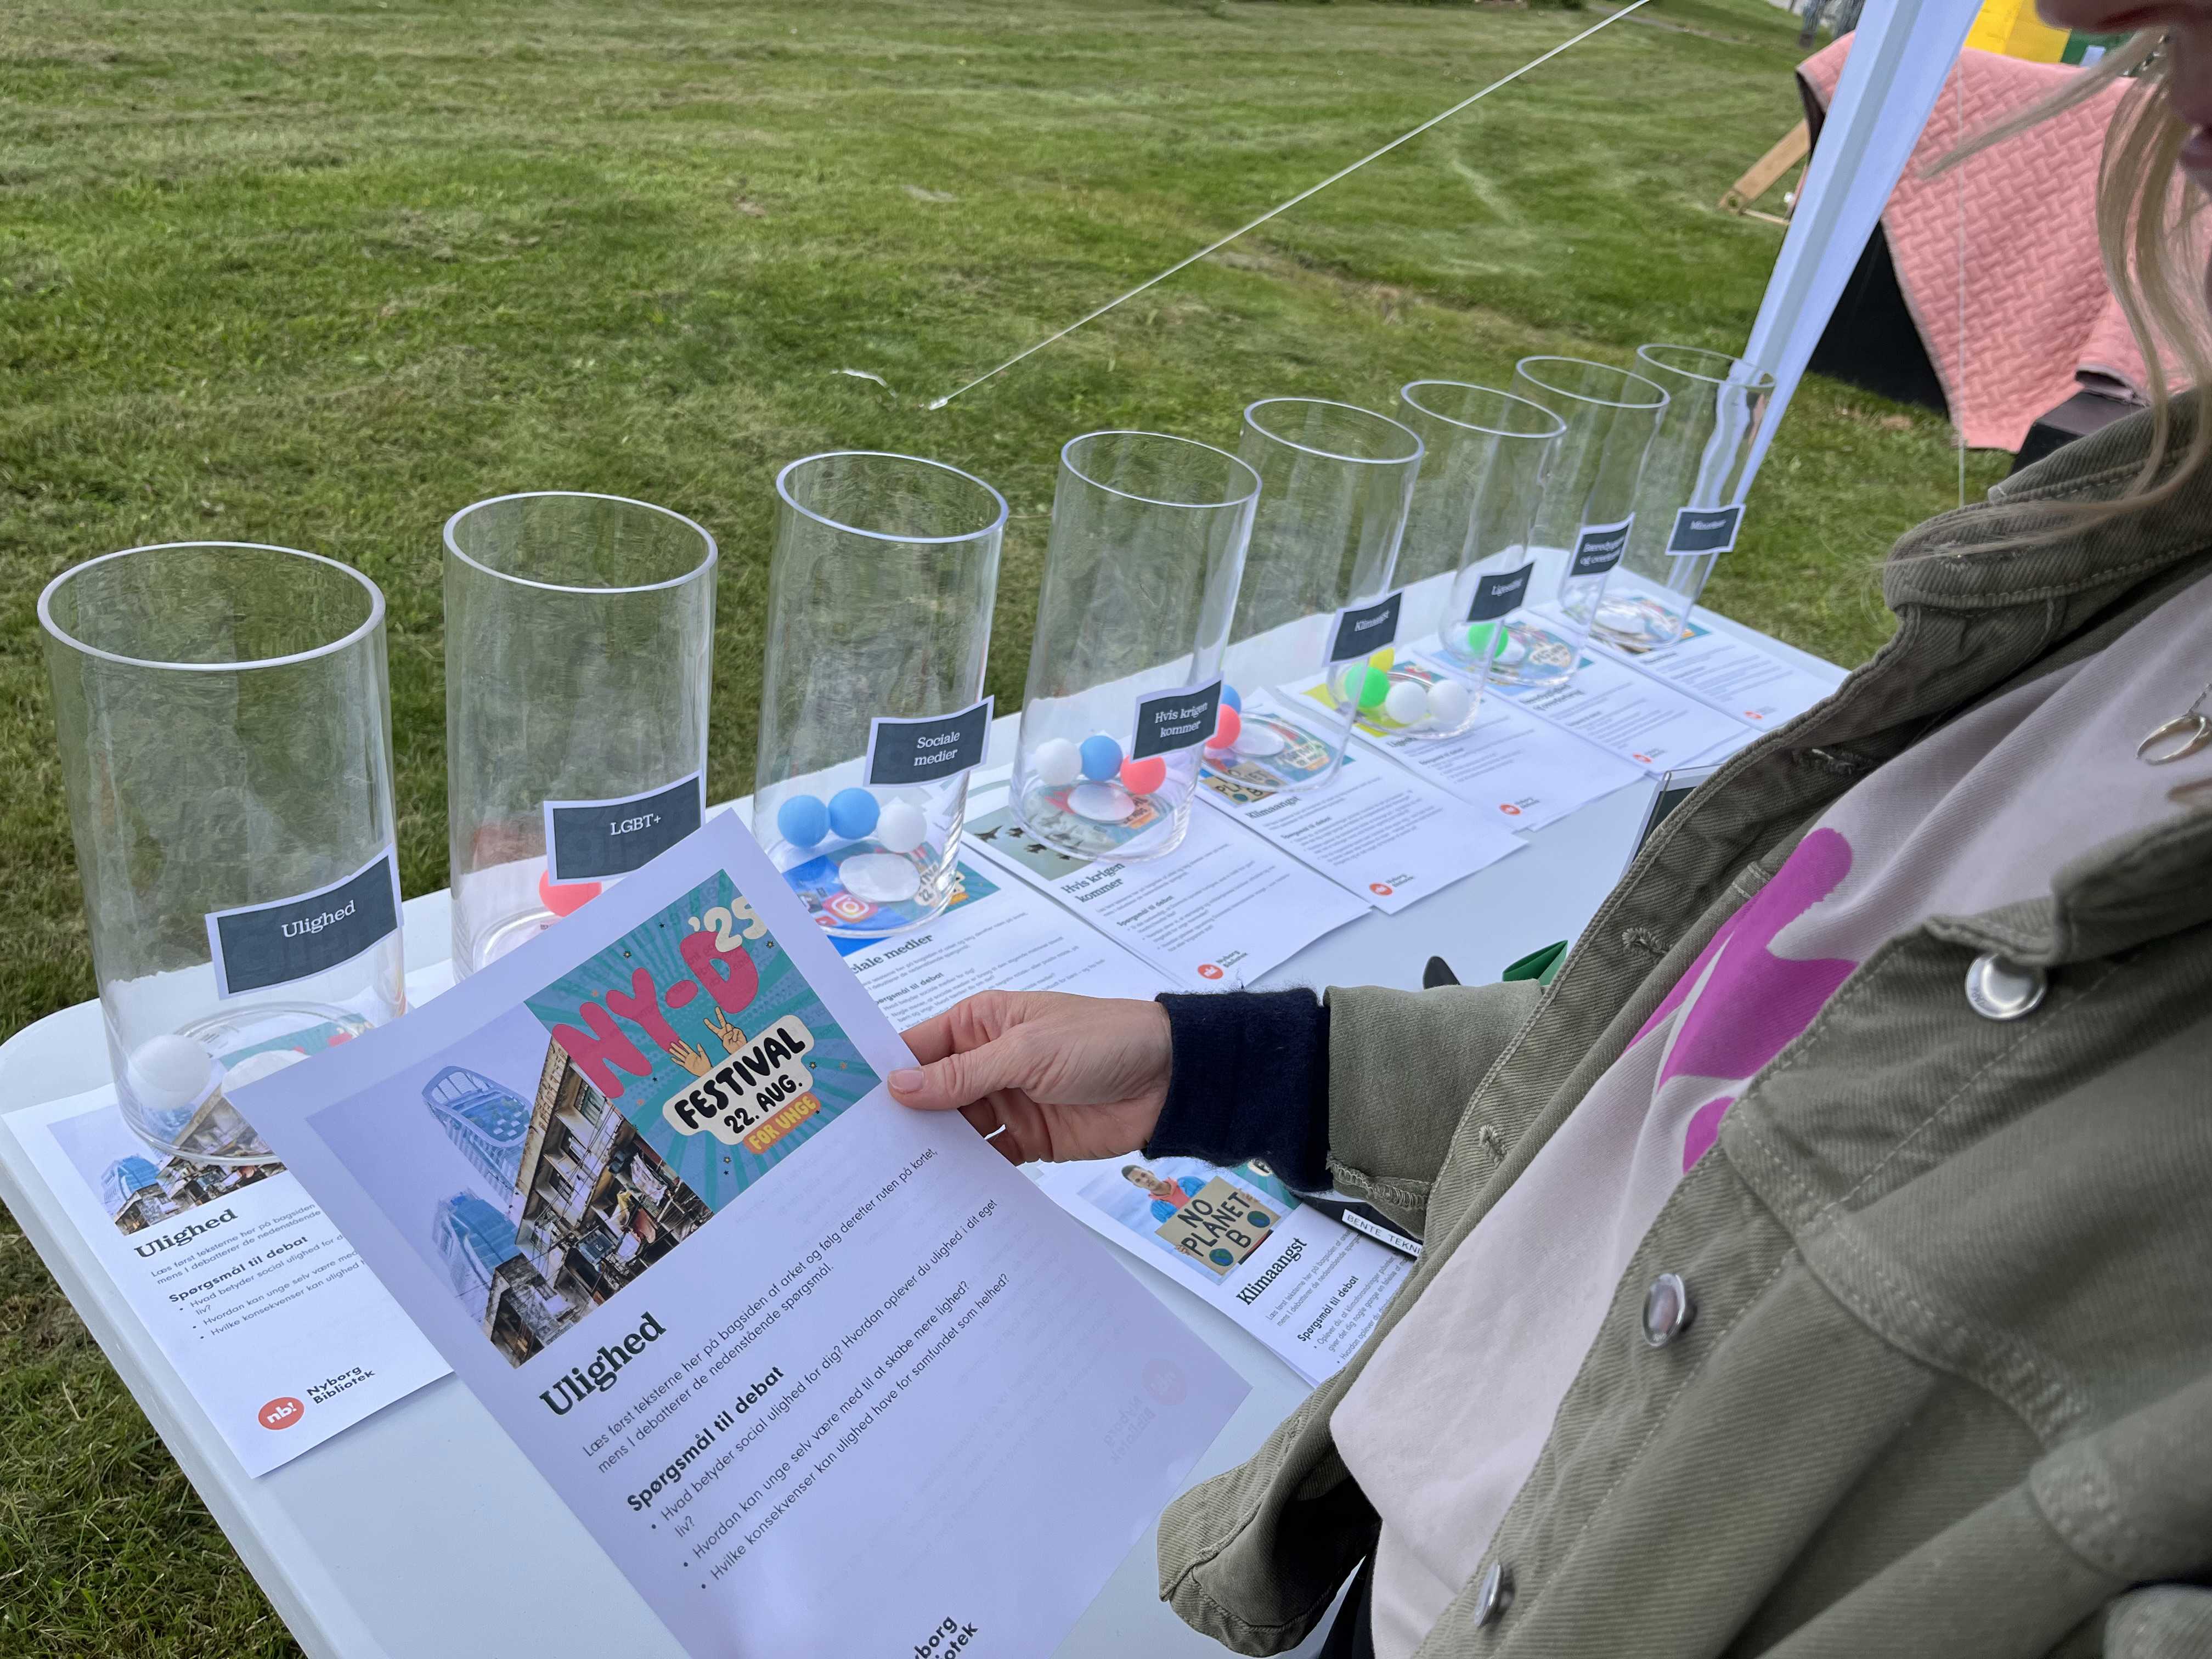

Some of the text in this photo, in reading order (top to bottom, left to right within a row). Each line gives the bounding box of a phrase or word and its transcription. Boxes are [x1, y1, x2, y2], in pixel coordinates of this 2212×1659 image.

[916, 731, 961, 749] Sociale
[1154, 702, 1208, 724] Hvis krigen
[1159, 720, 1201, 738] kommer
[913, 748, 958, 766] medier
[610, 812, 661, 836] LGBT+
[1060, 854, 1126, 894] Hvis krigen
[1074, 878, 1124, 903] kommer
[281, 899, 356, 938] Ulighed
[853, 956, 884, 973] ciale
[882, 934, 934, 960] medier
[552, 930, 759, 1098] NY-D
[674, 1028, 805, 1130] FESTIVAL
[724, 1074, 803, 1134] 22. AUG.
[748, 1096, 817, 1150] FOR UNGE
[133, 1208, 239, 1257] Ulighed
[150, 1204, 315, 1277] Læs først teksterne her på bagsiden
[1177, 1199, 1213, 1228] NO
[1181, 1191, 1250, 1257] PLANET
[1225, 1229, 1251, 1248] B
[1347, 1215, 1381, 1237] BENTE
[156, 1271, 183, 1285] mens
[191, 1244, 240, 1269] debatterer
[242, 1238, 255, 1246] de
[257, 1210, 321, 1240] nedenstående
[168, 1236, 308, 1302] Spørgsmål til debat
[189, 1238, 334, 1308] Hvad betyder social ulighed for
[1235, 1237, 1307, 1305] Klimaangst
[195, 1304, 211, 1316] liv?
[202, 1304, 245, 1325] Hvordan
[246, 1295, 265, 1306] kan
[266, 1283, 290, 1297] unge
[291, 1272, 310, 1285] selv
[311, 1260, 336, 1274] være
[210, 1261, 359, 1336] Hvilke konsekvenser kan ulighed
[582, 1148, 938, 1457] Læs først teksterne her på bagsiden af arket og følg derefter ruten på kortet,
[1297, 1304, 1334, 1341] Spørgsmål
[1329, 1296, 1341, 1306] til
[1338, 1275, 1359, 1297] debat
[306, 1366, 362, 1396] Nyborg
[312, 1370, 376, 1405] Bibliotek
[539, 1310, 667, 1415] Ulighed
[598, 1262, 834, 1474] mens I debatterer de nedenstående spørgsmål.
[660, 1199, 997, 1521] Hvad betyder social ulighed for dig? Hvordan oplever du ulighed i dit eget
[266, 1402, 298, 1424] nb!
[627, 1366, 785, 1511] Spørgsmål til debat
[692, 1280, 969, 1559] Hvordan kan unge selv være med til at skabe mere lighed?
[709, 1273, 1009, 1580] Hvilke konsekvenser kan ulighed have for samfundet som helhed?
[674, 1515, 695, 1538] liv?
